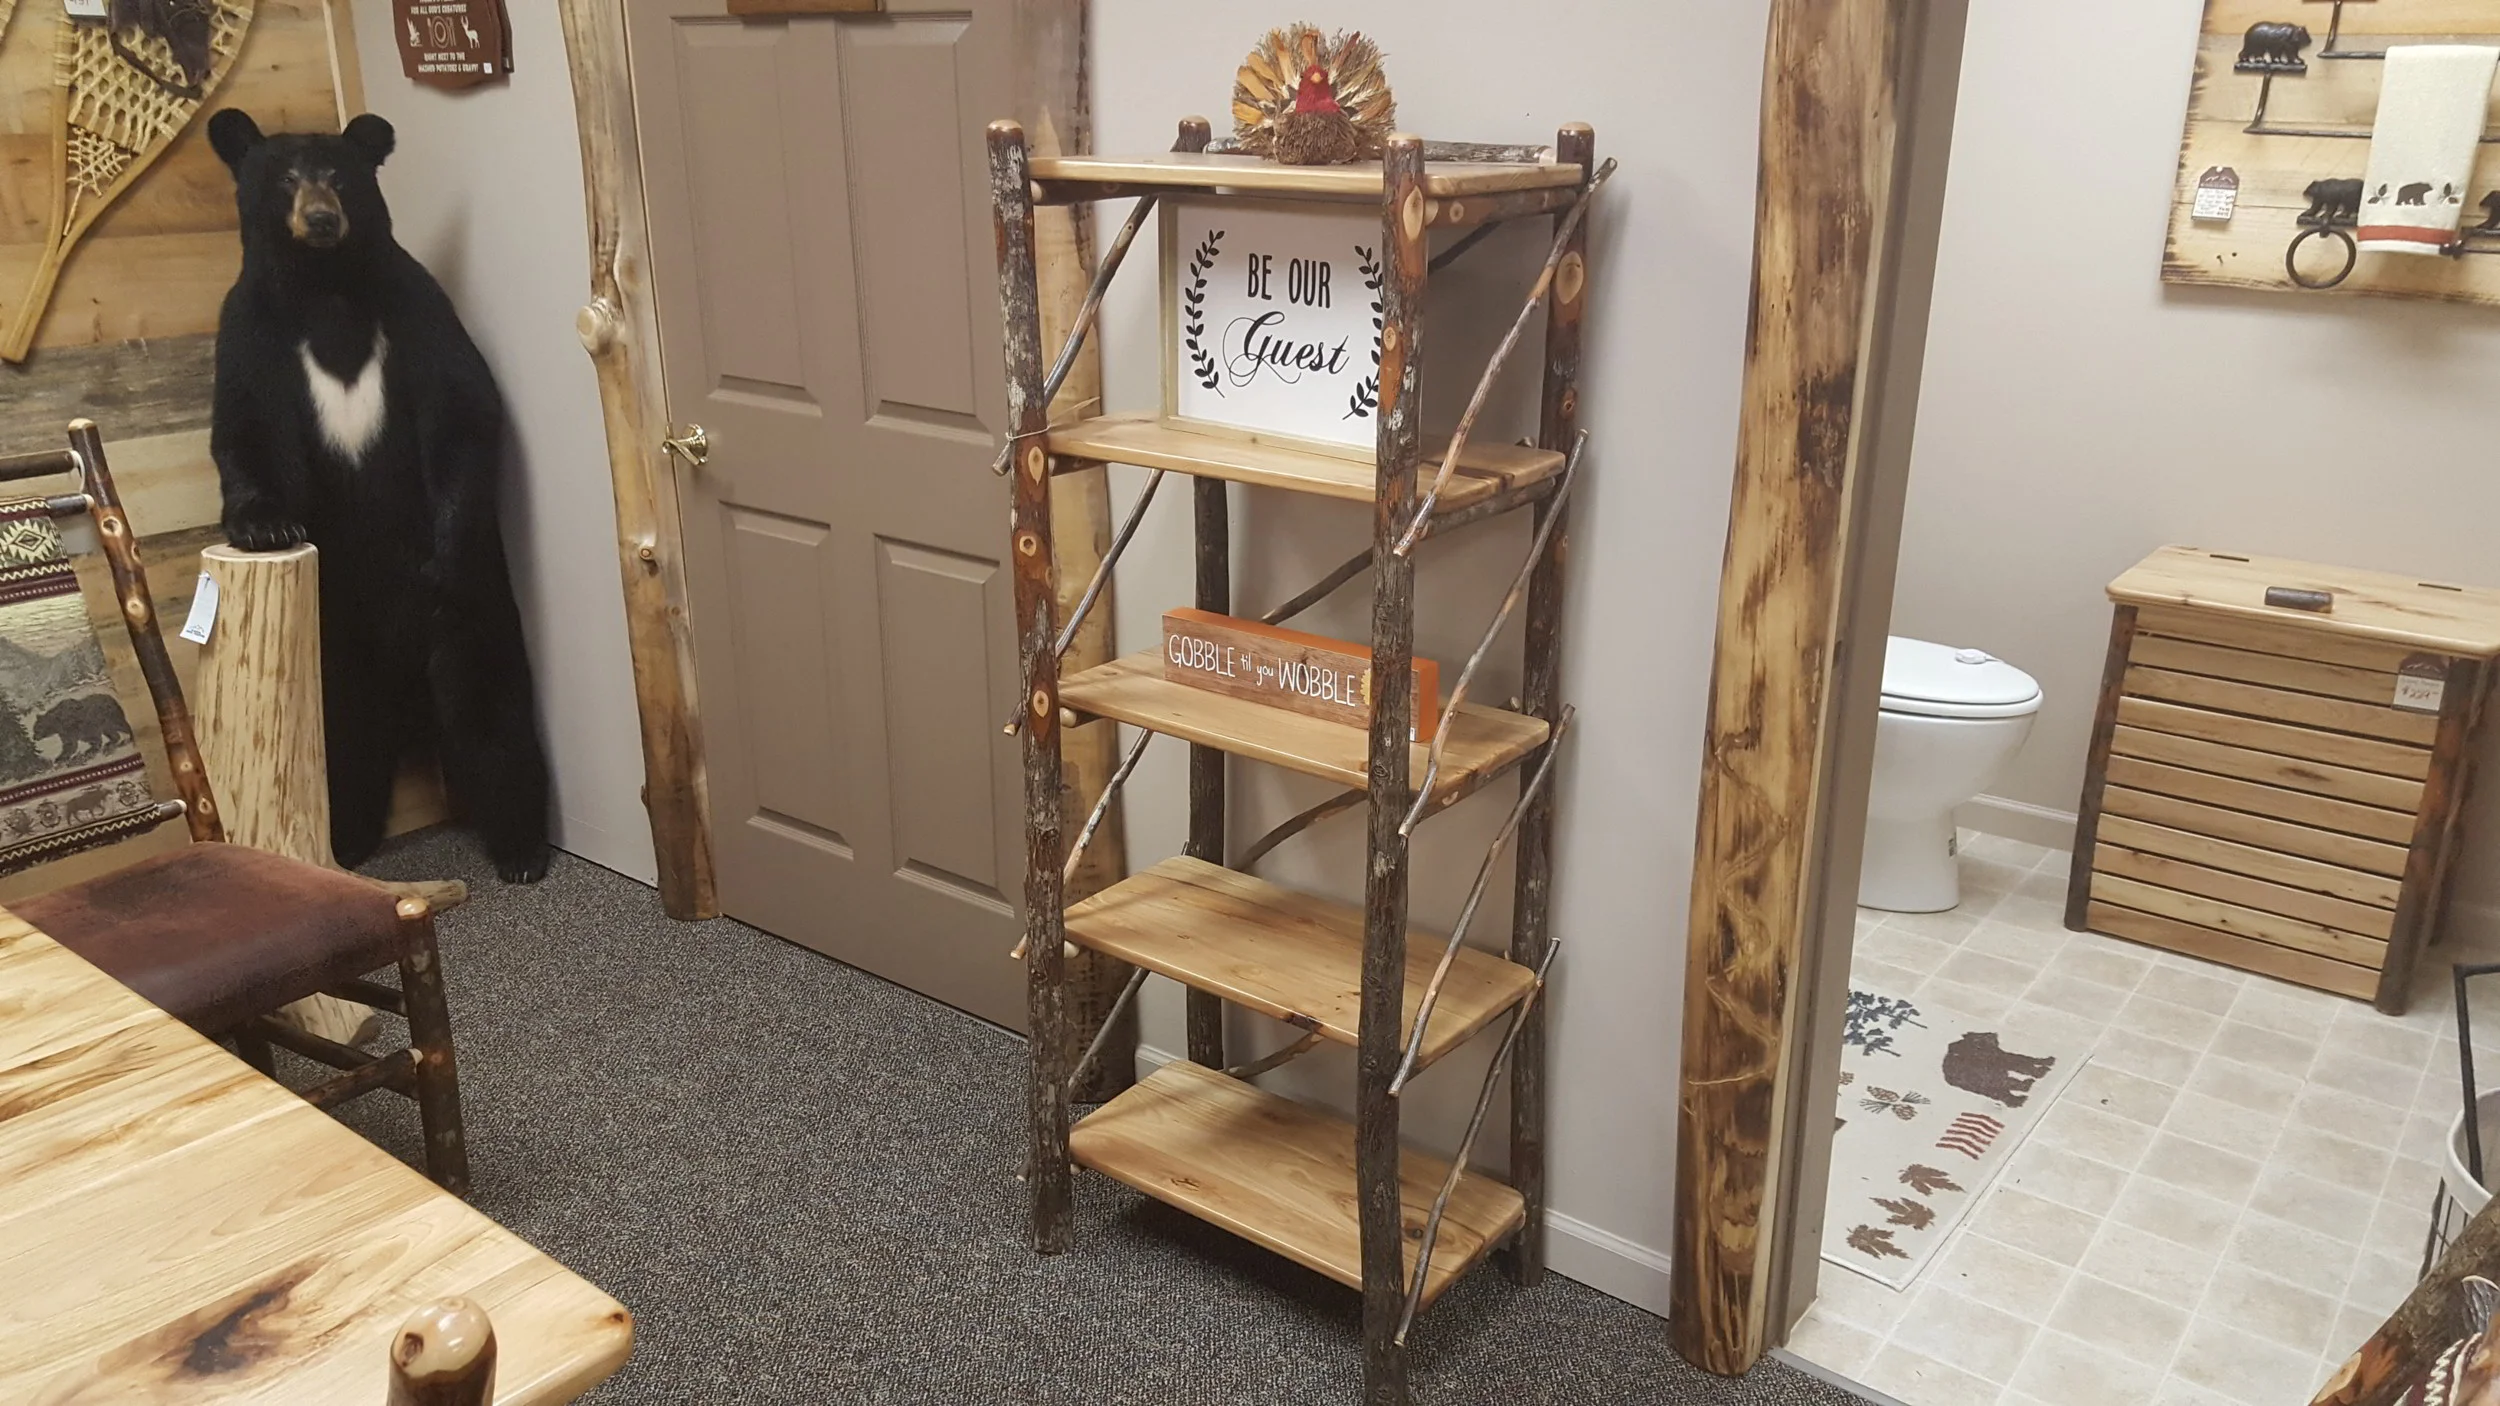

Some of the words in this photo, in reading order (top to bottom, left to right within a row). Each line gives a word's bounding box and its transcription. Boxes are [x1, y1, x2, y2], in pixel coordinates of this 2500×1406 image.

[420, 6, 428, 14] ALL
[449, 52, 456, 60] TO
[456, 52, 466, 61] THE
[1247, 253, 1272, 300] BE
[1288, 258, 1331, 309] OUR
[1223, 311, 1350, 387] Guest
[1168, 634, 1236, 678] GOBBLE
[1240, 652, 1251, 672] til
[1256, 664, 1274, 686] you
[1278, 658, 1356, 707] WOBBLE
